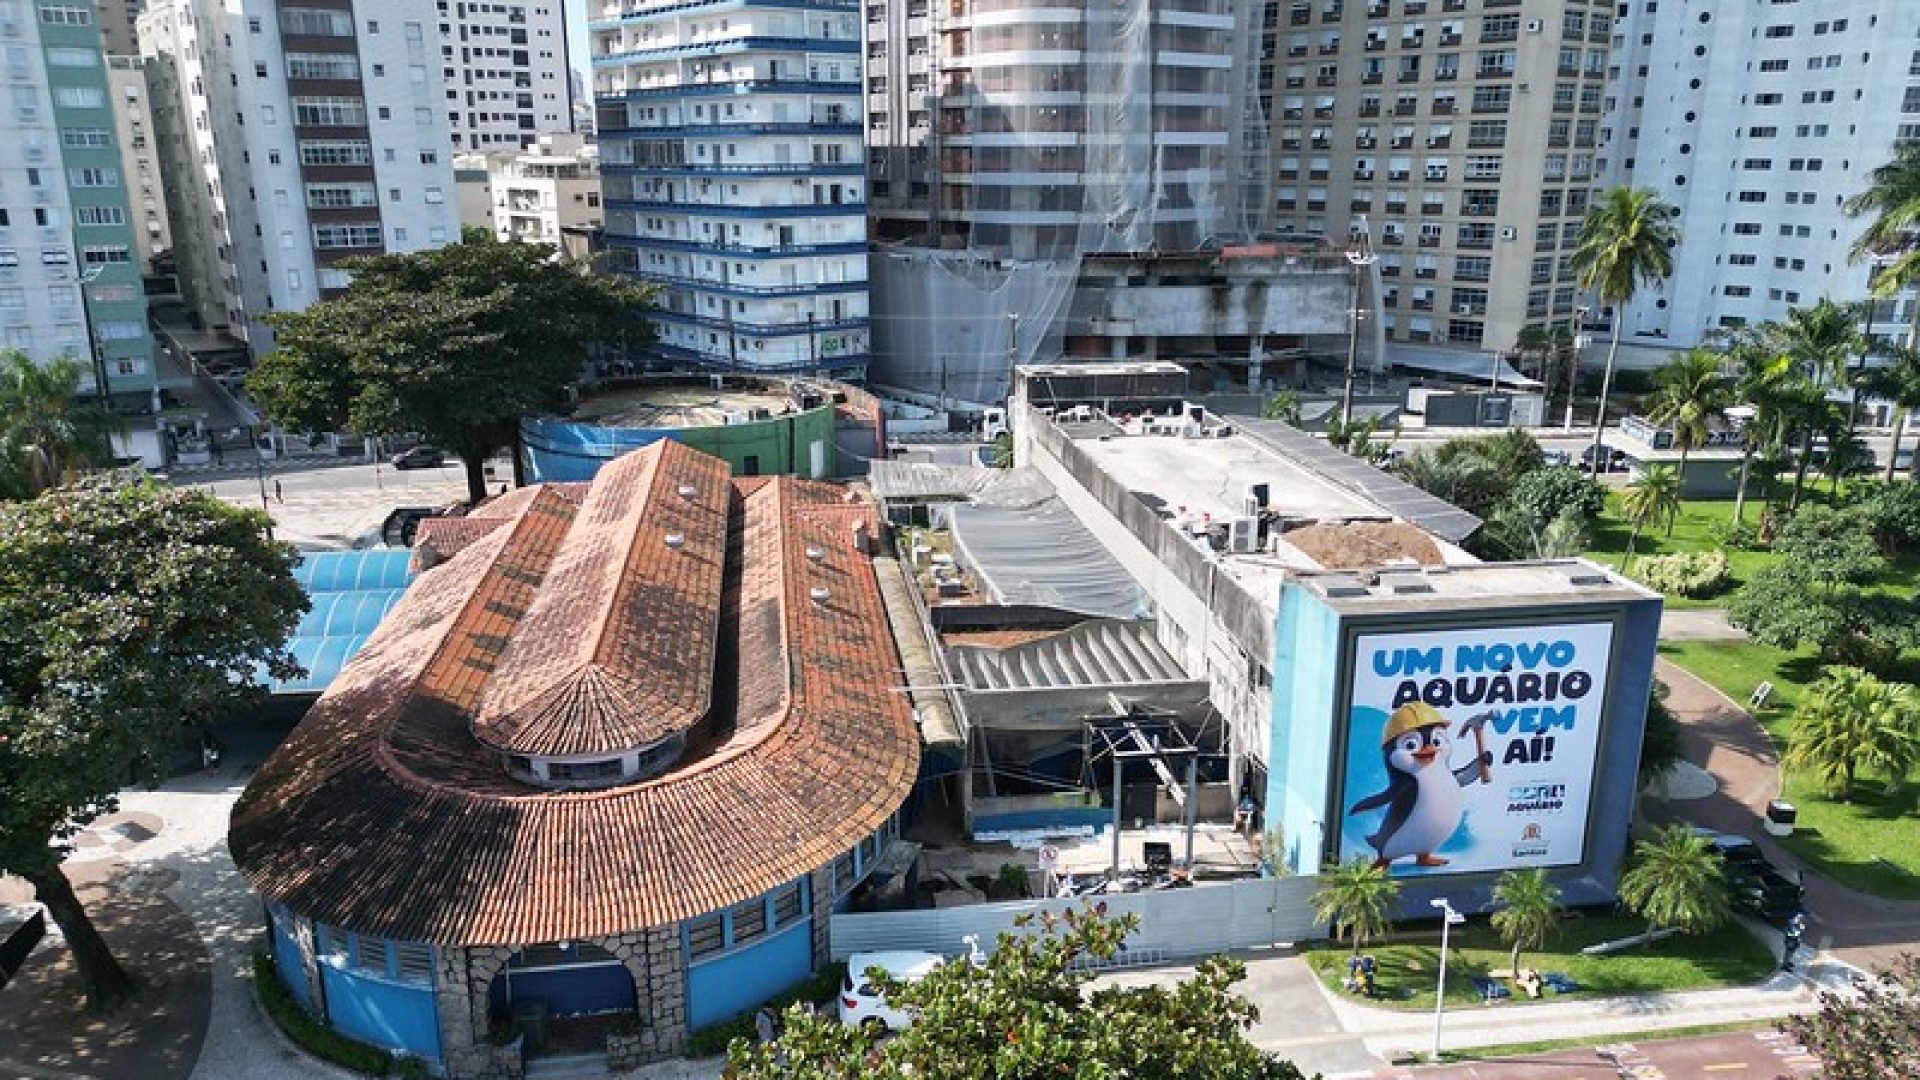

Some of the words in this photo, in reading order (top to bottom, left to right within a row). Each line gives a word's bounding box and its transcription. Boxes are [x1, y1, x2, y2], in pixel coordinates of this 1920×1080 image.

[1373, 647, 1443, 677] UM
[1456, 640, 1575, 673] NOVO
[1392, 663, 1592, 709] AQUÁRIO
[1490, 705, 1576, 734] VEM
[1502, 724, 1555, 764] AÍ!
